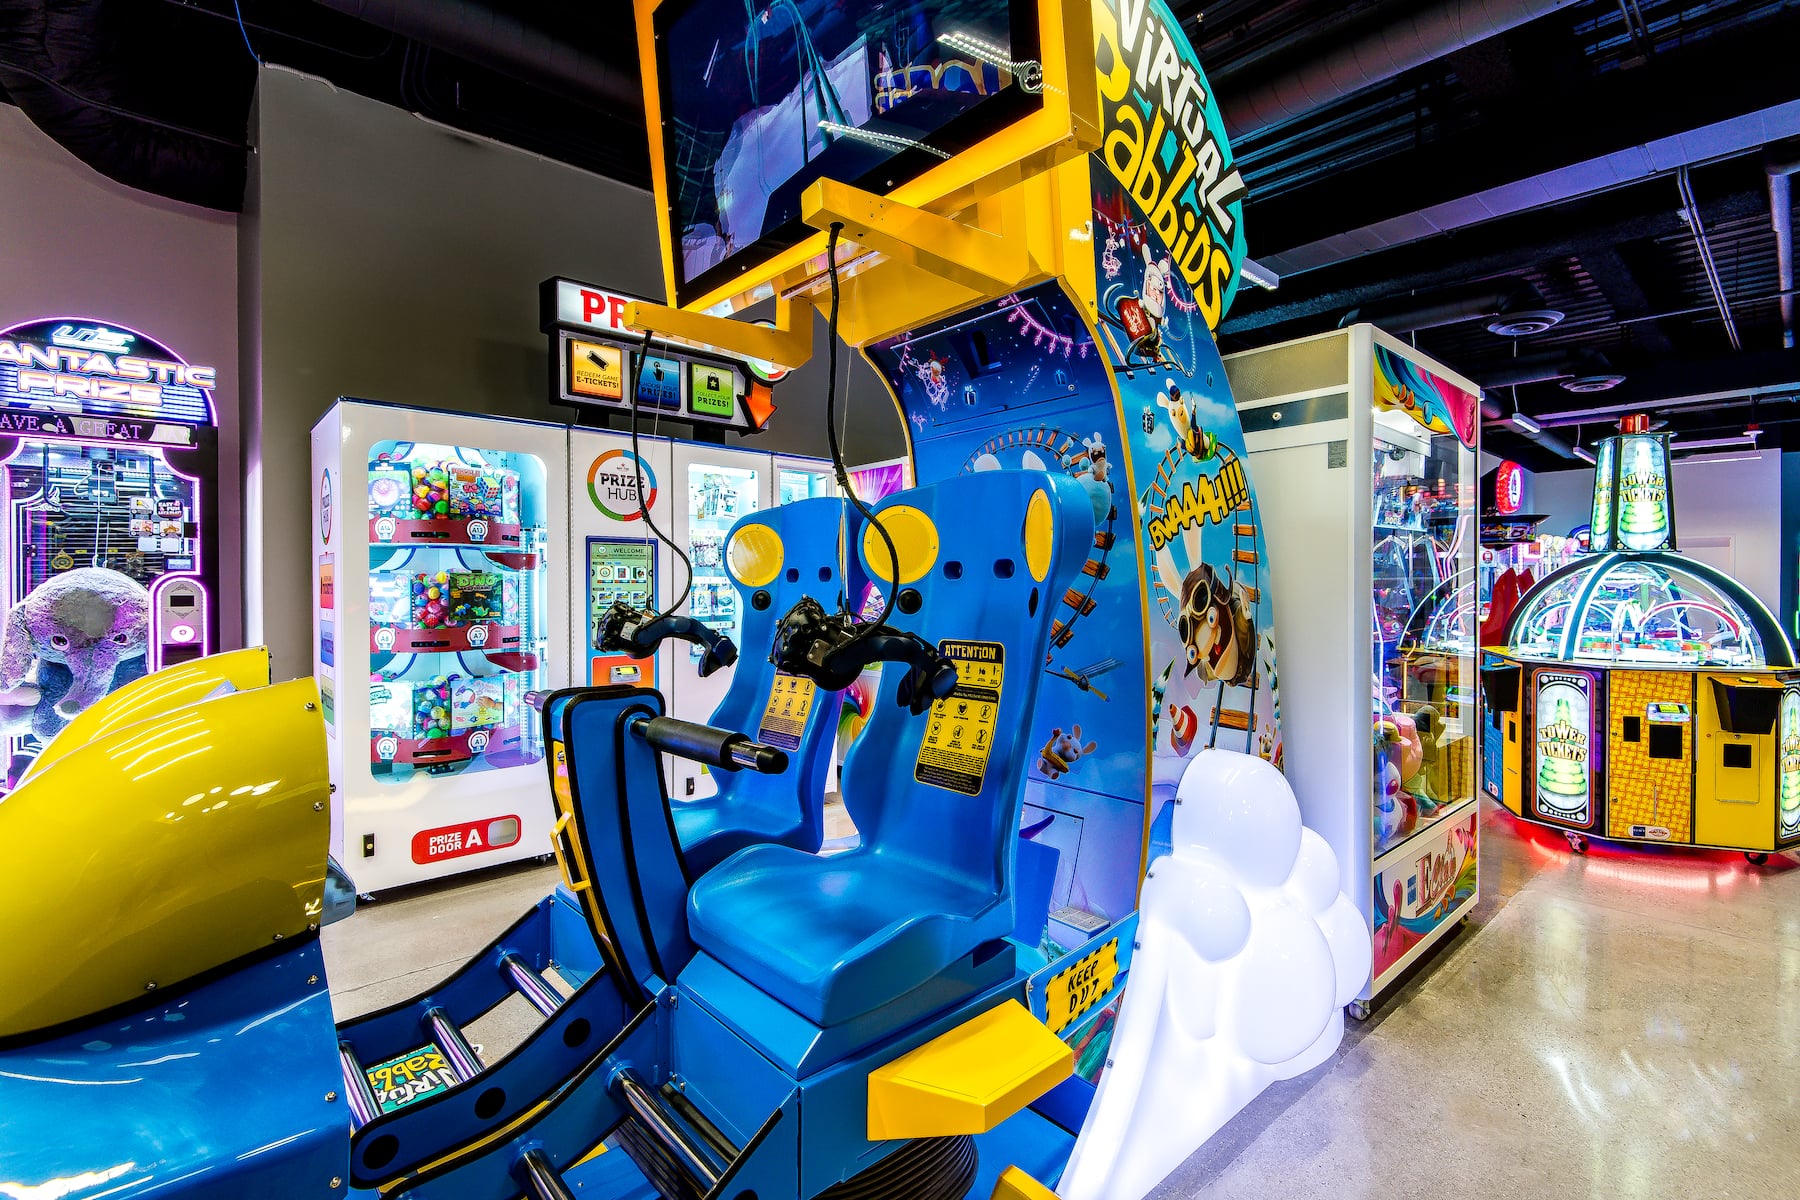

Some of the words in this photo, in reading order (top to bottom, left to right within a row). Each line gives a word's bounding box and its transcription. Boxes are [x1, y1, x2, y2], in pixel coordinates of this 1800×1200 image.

[576, 370, 601, 379] REDEEM
[576, 375, 619, 388] E-TICKETS!
[18, 370, 163, 406] PRIZE
[641, 387, 676, 399] PRIZES!
[697, 396, 729, 408] PRIZES!
[79, 420, 142, 442] GREAT
[600, 472, 645, 489] PRIZE
[1620, 470, 1665, 488] TOWER
[607, 487, 638, 501] HUB
[1620, 488, 1666, 503] TICKETS
[613, 547, 645, 555] WELCOME
[944, 643, 996, 660] ATTENTION
[1539, 719, 1587, 746] TOWER
[1538, 741, 1588, 763] TICKETS
[429, 831, 462, 846] PRIZE
[464, 828, 483, 849] A
[429, 841, 462, 856] DOOR
[1067, 959, 1099, 993] KEEP
[1069, 978, 1100, 1014] OUT
